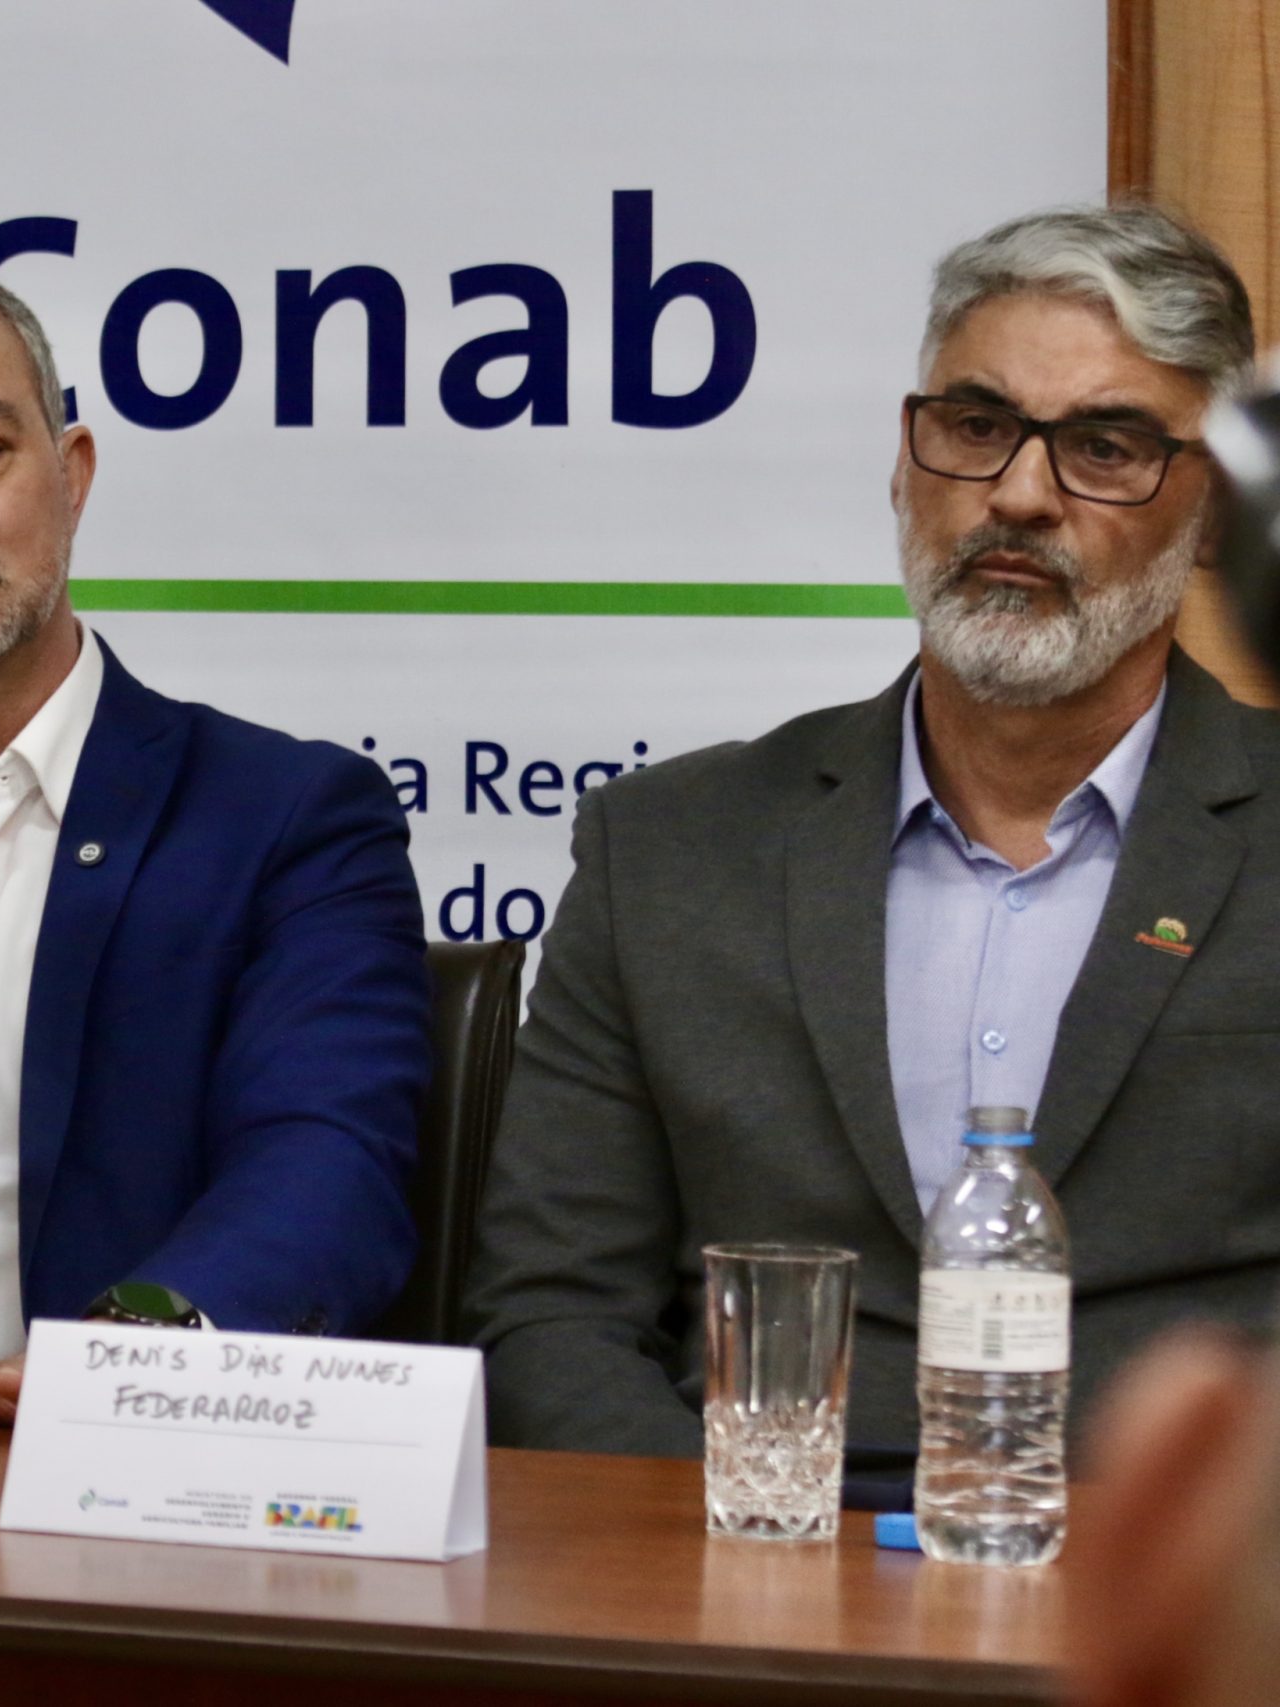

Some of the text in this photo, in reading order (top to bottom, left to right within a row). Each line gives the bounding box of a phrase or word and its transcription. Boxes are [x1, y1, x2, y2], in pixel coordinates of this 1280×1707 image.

[438, 863, 545, 942] do
[306, 1357, 414, 1386] NUNES
[113, 1385, 317, 1428] FEDERARROZ
